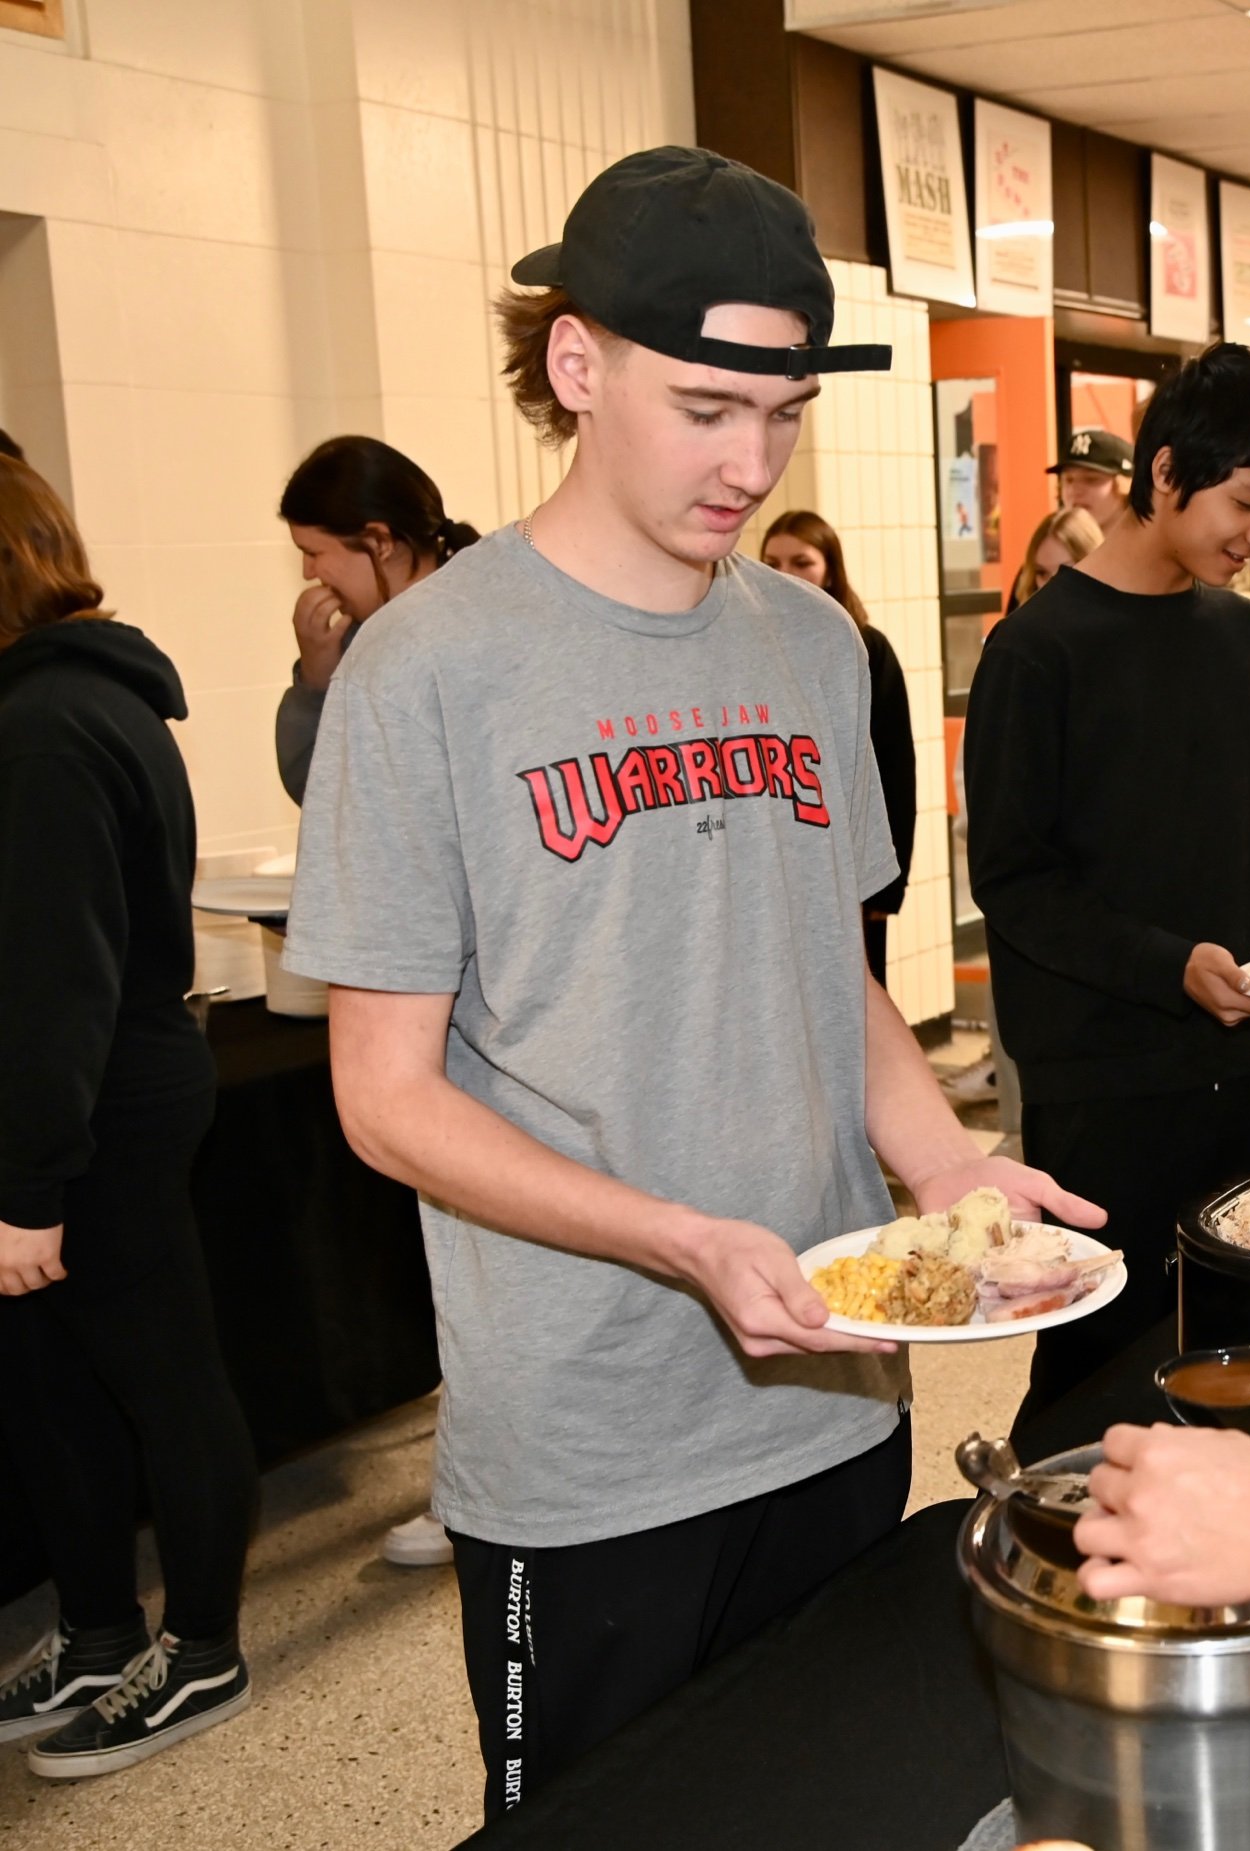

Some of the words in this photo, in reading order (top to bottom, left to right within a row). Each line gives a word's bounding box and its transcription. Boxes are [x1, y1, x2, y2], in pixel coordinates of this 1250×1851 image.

[896, 164, 952, 215] MASH
[596, 707, 704, 740] MOOSE
[721, 704, 770, 727] JAW
[515, 734, 830, 863] WARRORS
[506, 1558, 524, 1645] BURTON
[506, 1660, 523, 1740] BURTON
[505, 1757, 522, 1811] BURT
